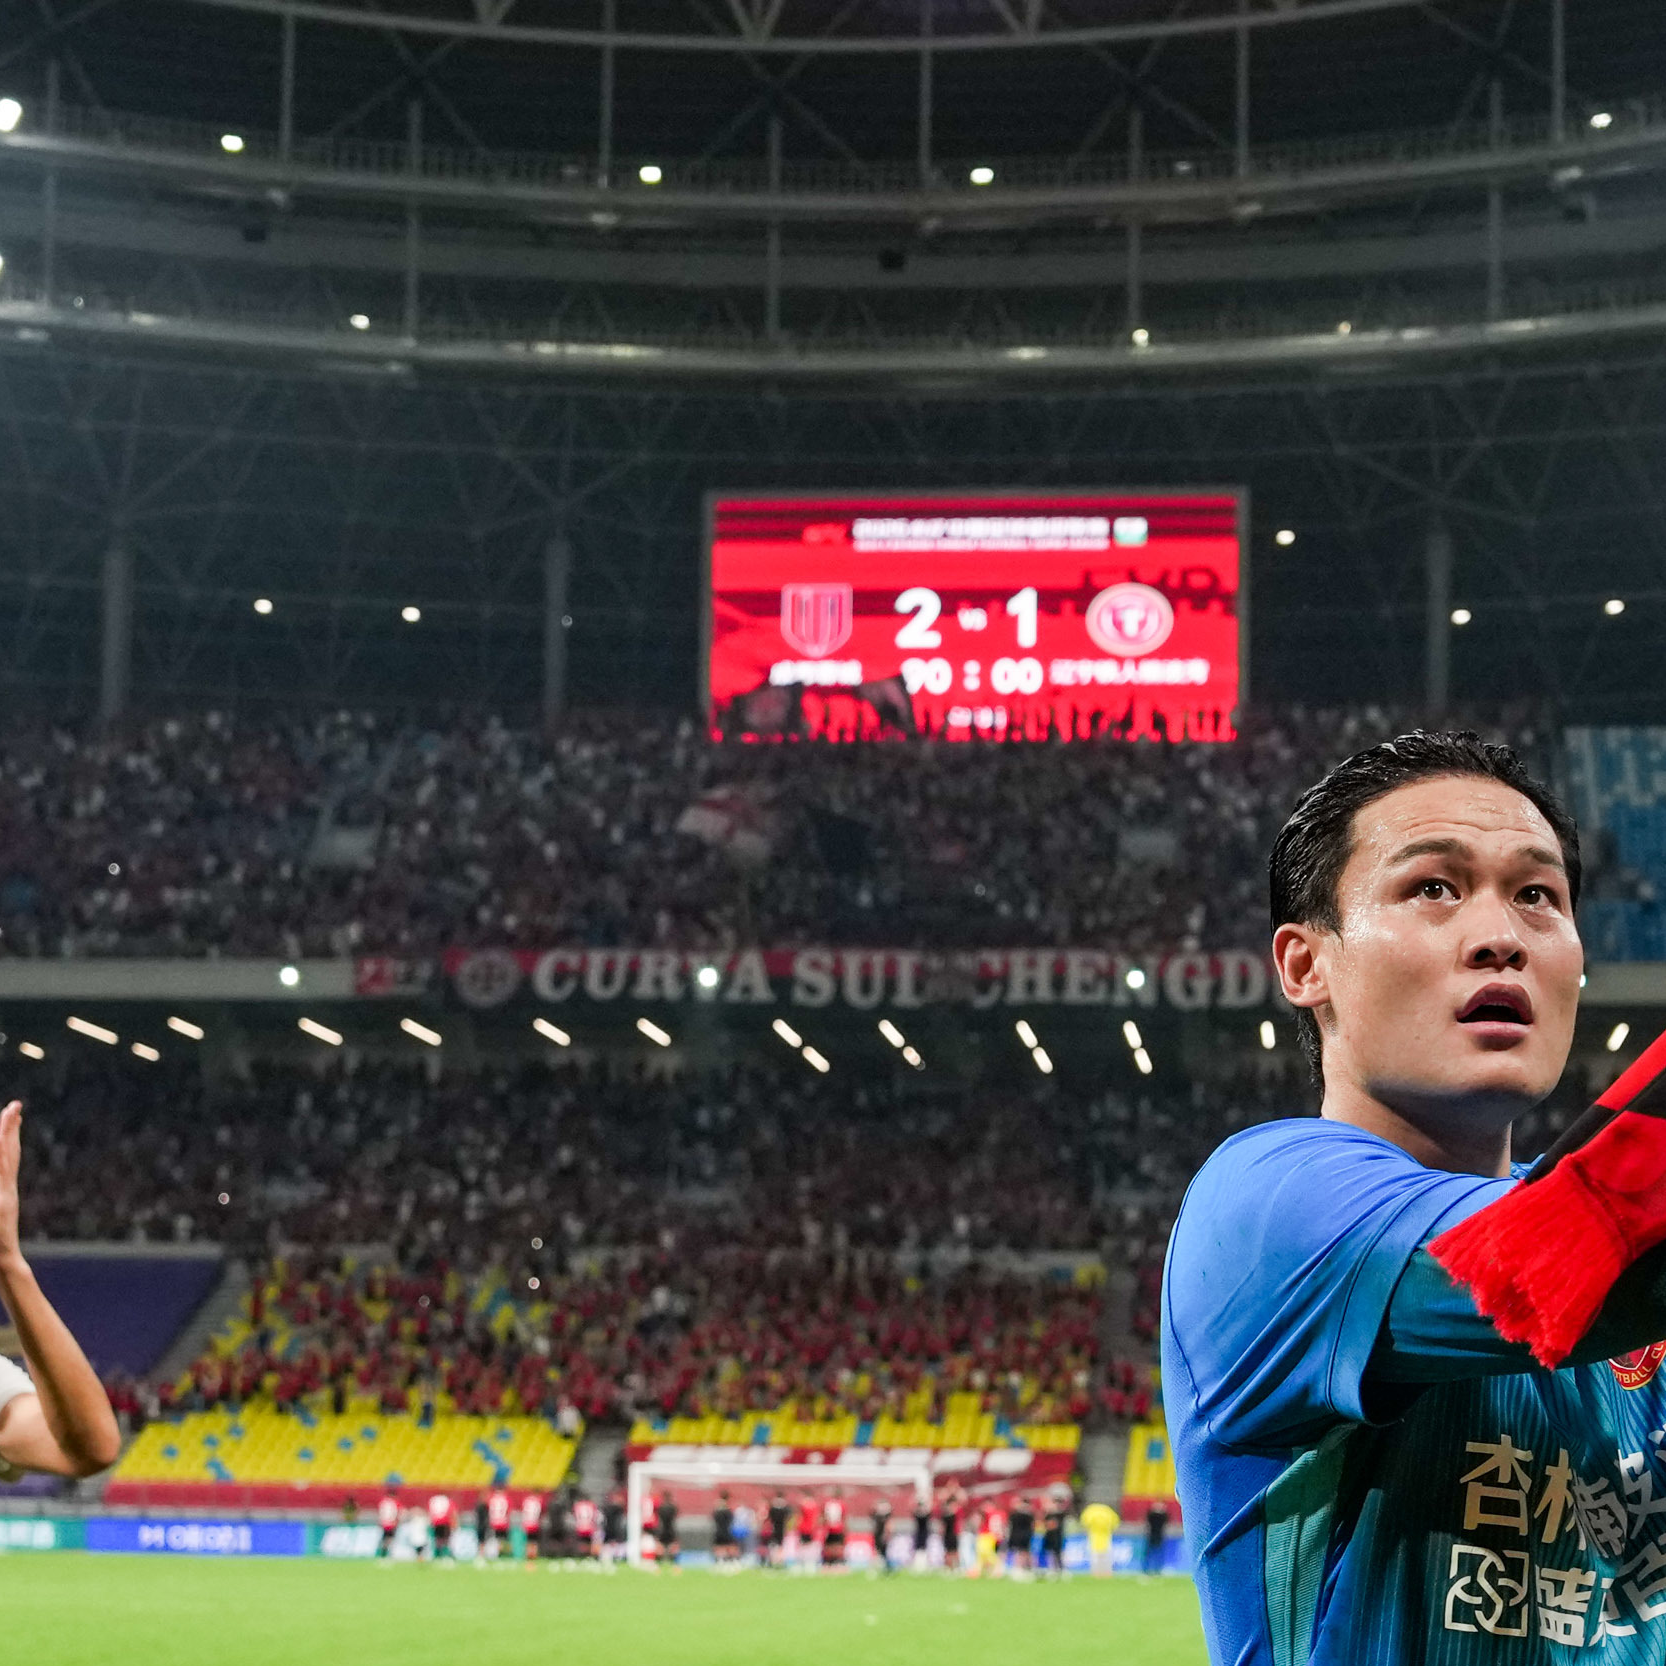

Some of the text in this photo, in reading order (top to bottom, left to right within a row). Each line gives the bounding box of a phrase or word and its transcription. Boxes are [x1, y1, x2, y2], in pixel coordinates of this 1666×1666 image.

[895, 586, 942, 649] 2
[1006, 587, 1038, 649] 1
[533, 948, 778, 1002] CURVA
